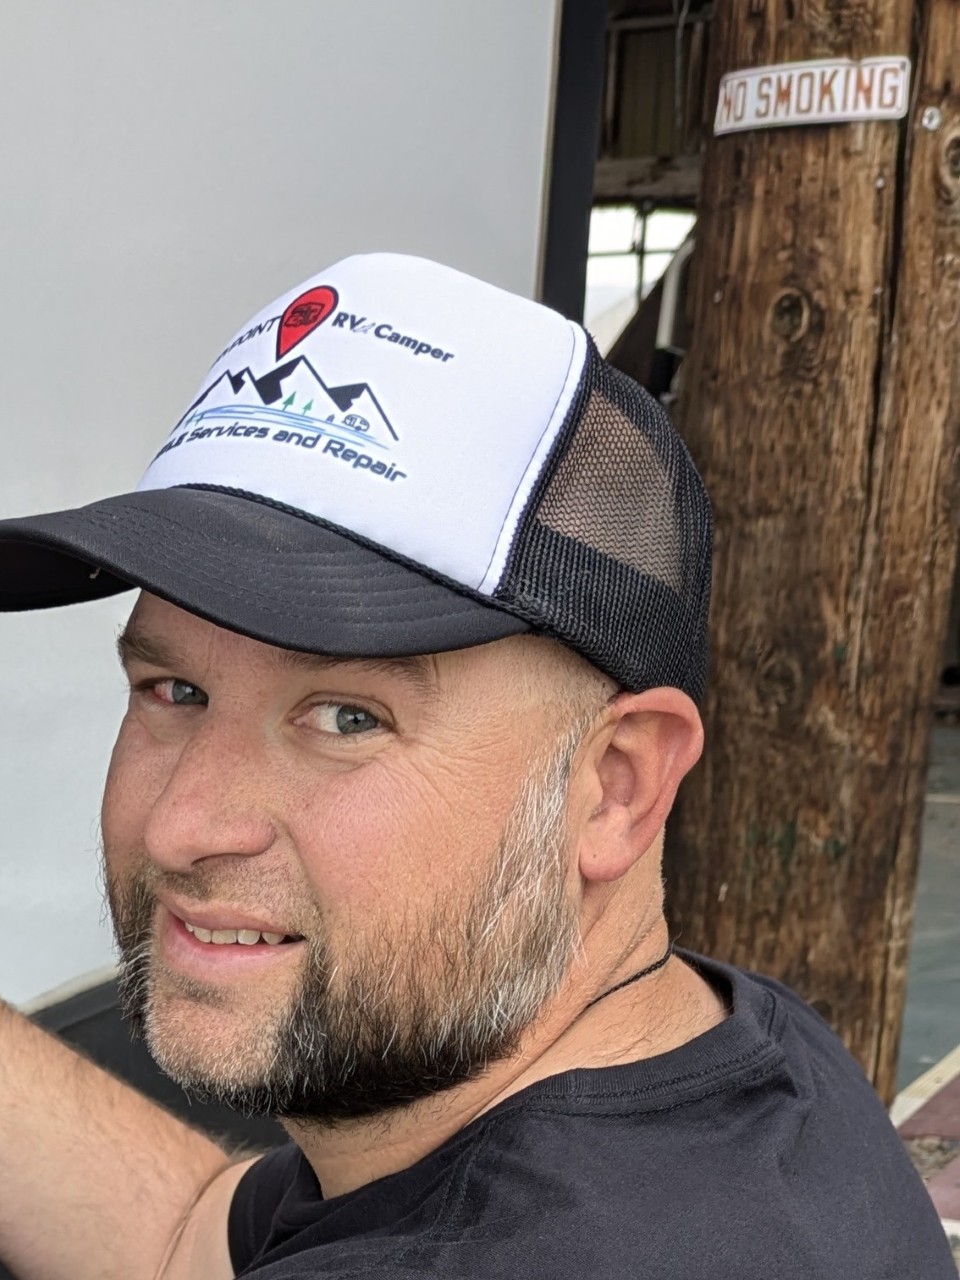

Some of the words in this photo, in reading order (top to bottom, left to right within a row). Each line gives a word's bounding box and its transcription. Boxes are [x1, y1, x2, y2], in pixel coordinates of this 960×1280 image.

[718, 80, 747, 124] NO
[755, 67, 900, 118] SMOKING
[332, 311, 367, 331] RV
[374, 324, 455, 362] Camper
[186, 421, 270, 442] Services
[272, 432, 321, 450] and
[322, 439, 407, 482] Repair
